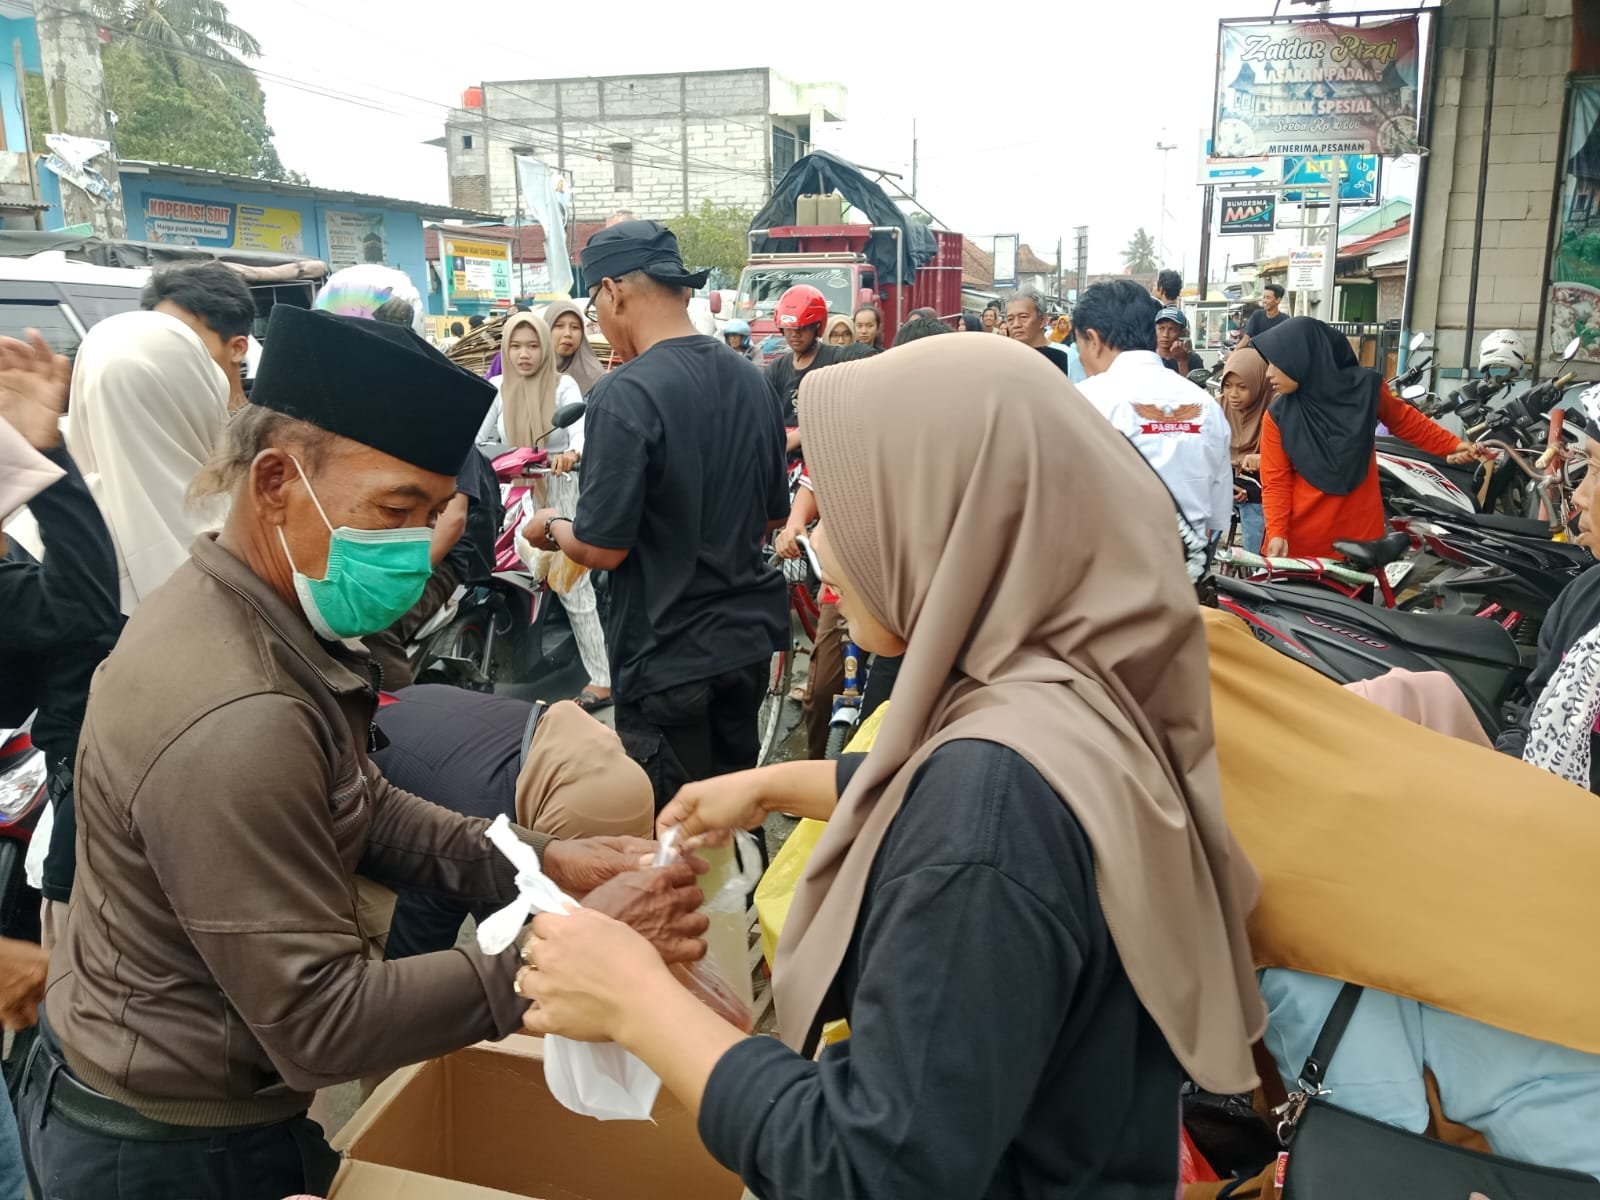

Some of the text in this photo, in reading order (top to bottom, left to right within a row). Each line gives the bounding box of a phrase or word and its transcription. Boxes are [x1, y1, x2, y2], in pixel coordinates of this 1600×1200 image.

[1330, 35, 1399, 64] Rizqi
[1328, 68, 1382, 82] PADANG
[1318, 99, 1373, 114] SPESIAL
[1274, 118, 1306, 132] Serba
[1310, 119, 1329, 133] Rp
[1268, 142, 1365, 153] MENERIMA PESANAN
[150, 199, 230, 224] KOPERASI SDIT
[1227, 200, 1267, 208] BUMDESMA
